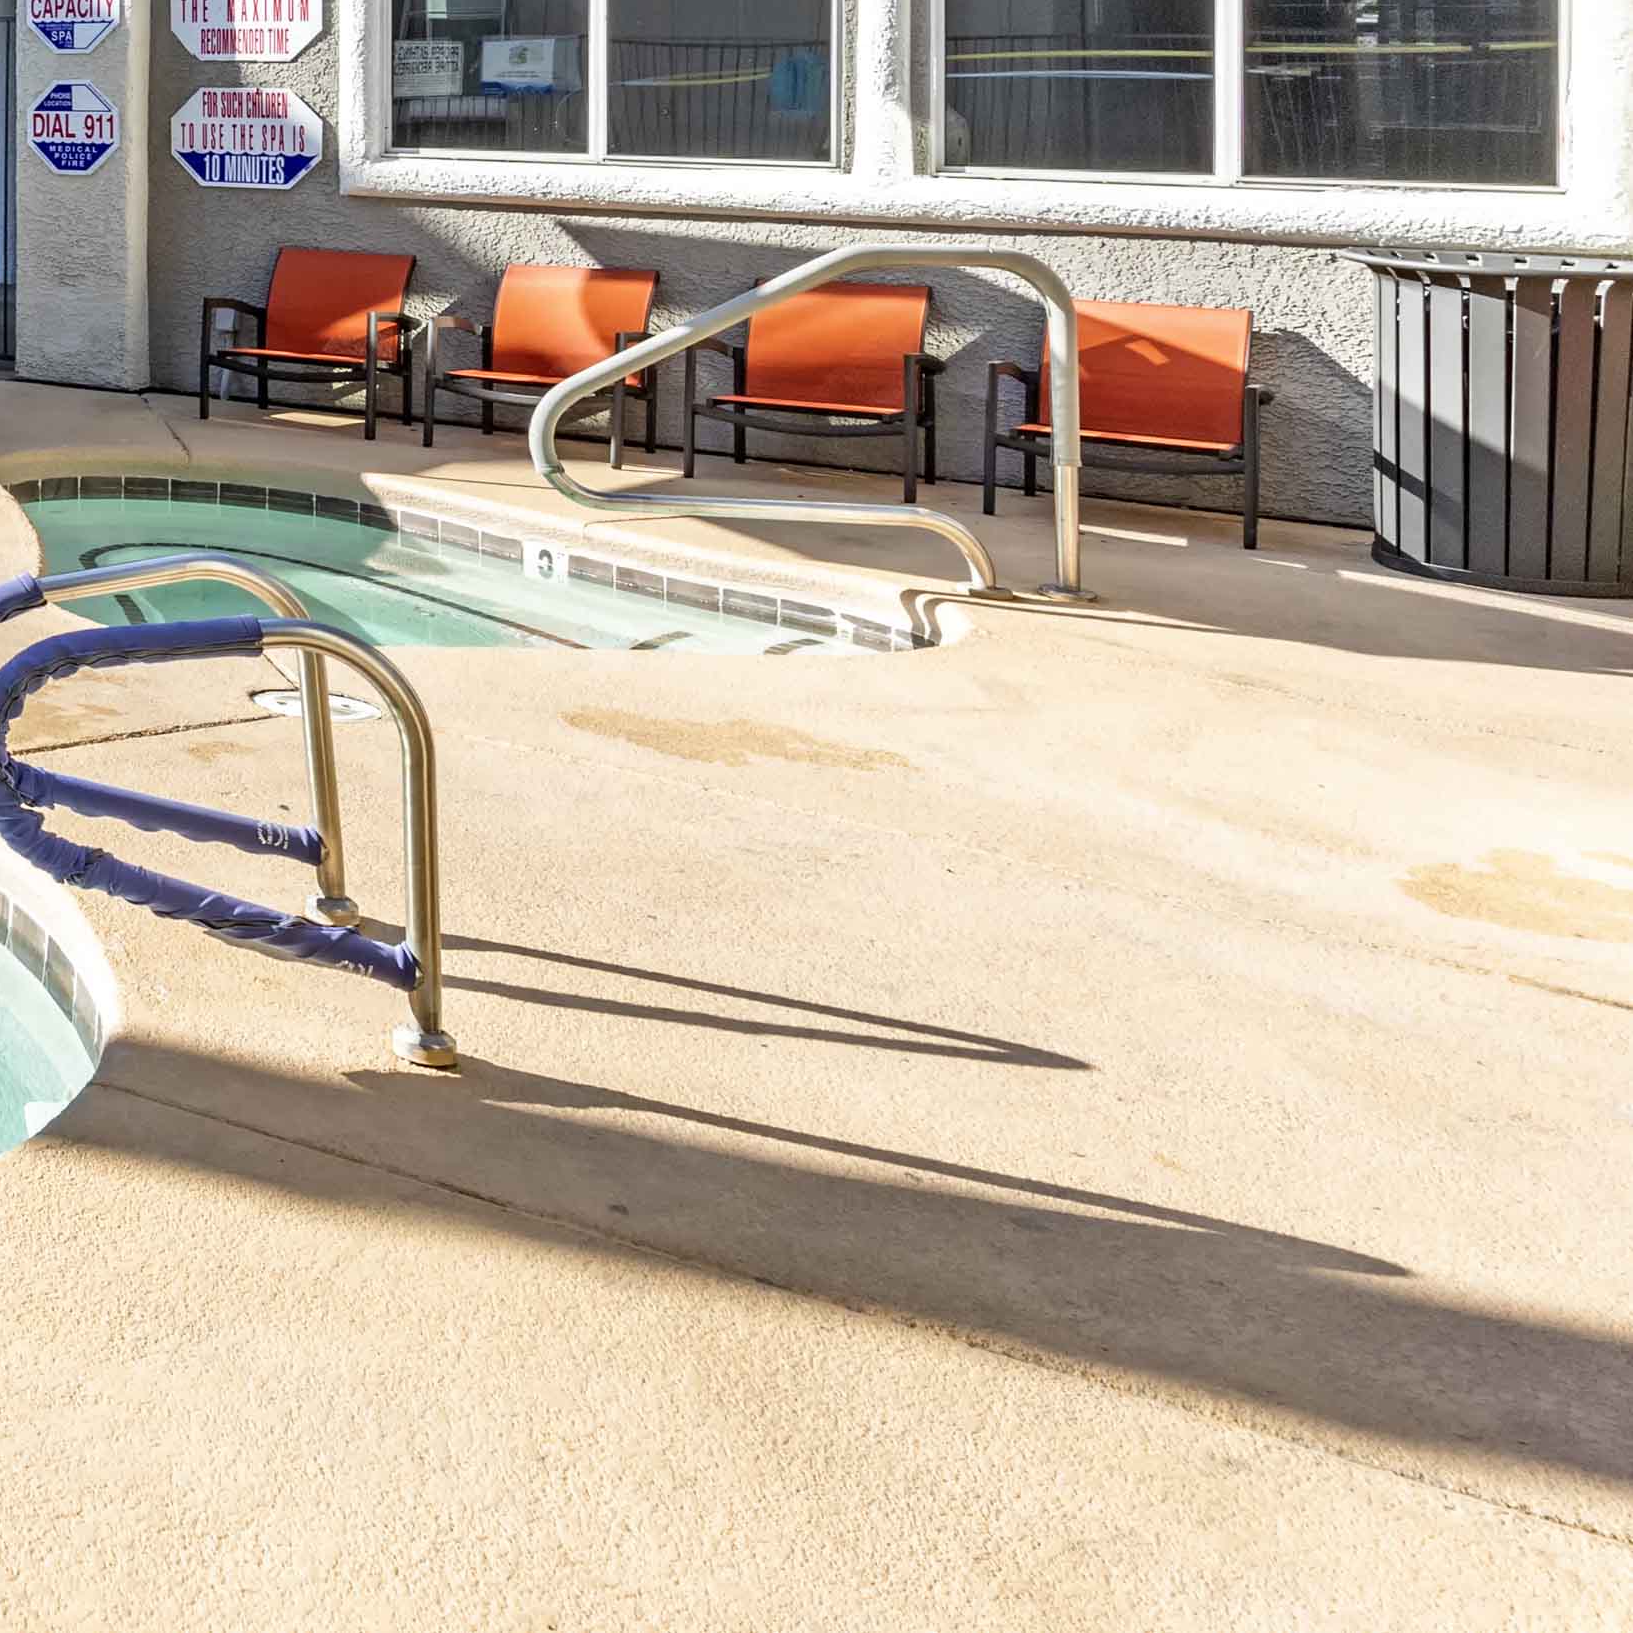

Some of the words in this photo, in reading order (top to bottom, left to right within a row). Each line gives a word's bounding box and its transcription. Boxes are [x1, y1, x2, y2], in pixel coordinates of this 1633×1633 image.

[51, 31, 72, 41] SPA
[201, 28, 264, 55] RECOMMENDED
[268, 28, 289, 54] TIME
[203, 92, 218, 117] FOR
[221, 92, 243, 118] SUCH
[246, 92, 288, 119] CHILDREN
[33, 114, 76, 137] DIAL
[85, 114, 113, 139] 911
[181, 123, 194, 149] TO
[203, 123, 224, 149] USE
[232, 124, 253, 150] THE
[262, 125, 285, 151] SPA
[293, 125, 305, 152] IS
[49, 145, 98, 153] MEDICAL
[204, 155, 220, 181] 10
[224, 155, 285, 184] MINUTES
